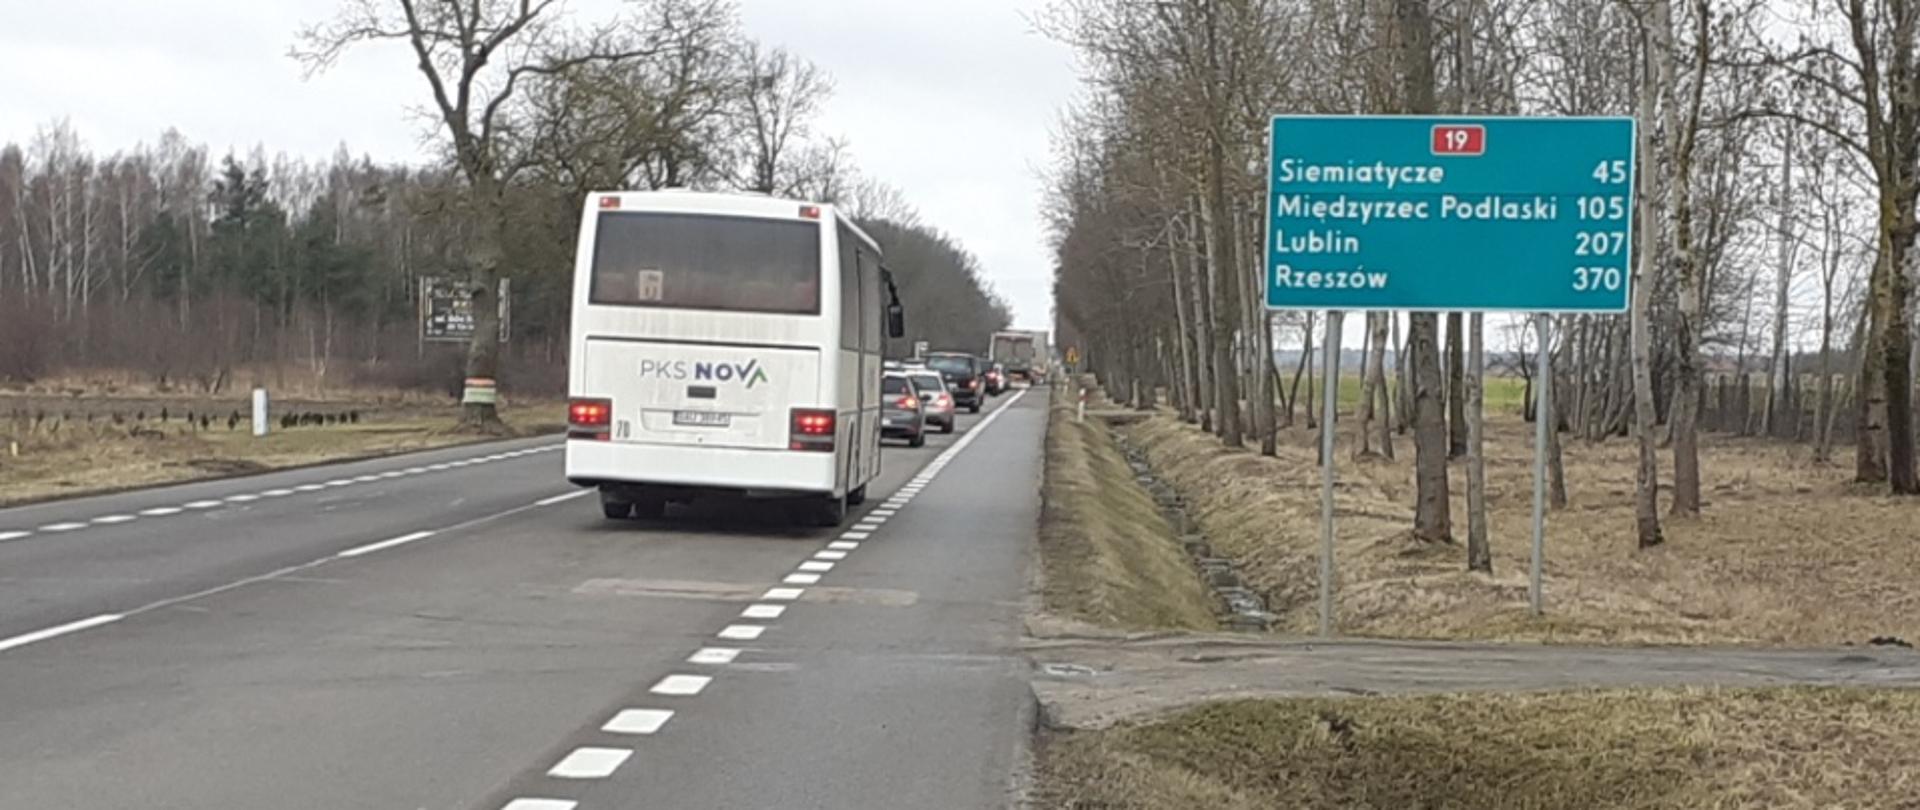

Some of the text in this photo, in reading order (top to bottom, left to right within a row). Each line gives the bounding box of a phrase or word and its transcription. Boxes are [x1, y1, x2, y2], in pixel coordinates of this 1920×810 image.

[1445, 130, 1468, 150] 19
[1279, 158, 1627, 190] Siemiatycze 45
[1277, 194, 1624, 225] Międzyrzec Podlaski 105
[1276, 229, 1625, 256] Lublin 207
[1275, 263, 1621, 291] Rzeszów 370
[640, 358, 768, 389] PKS NOVA
